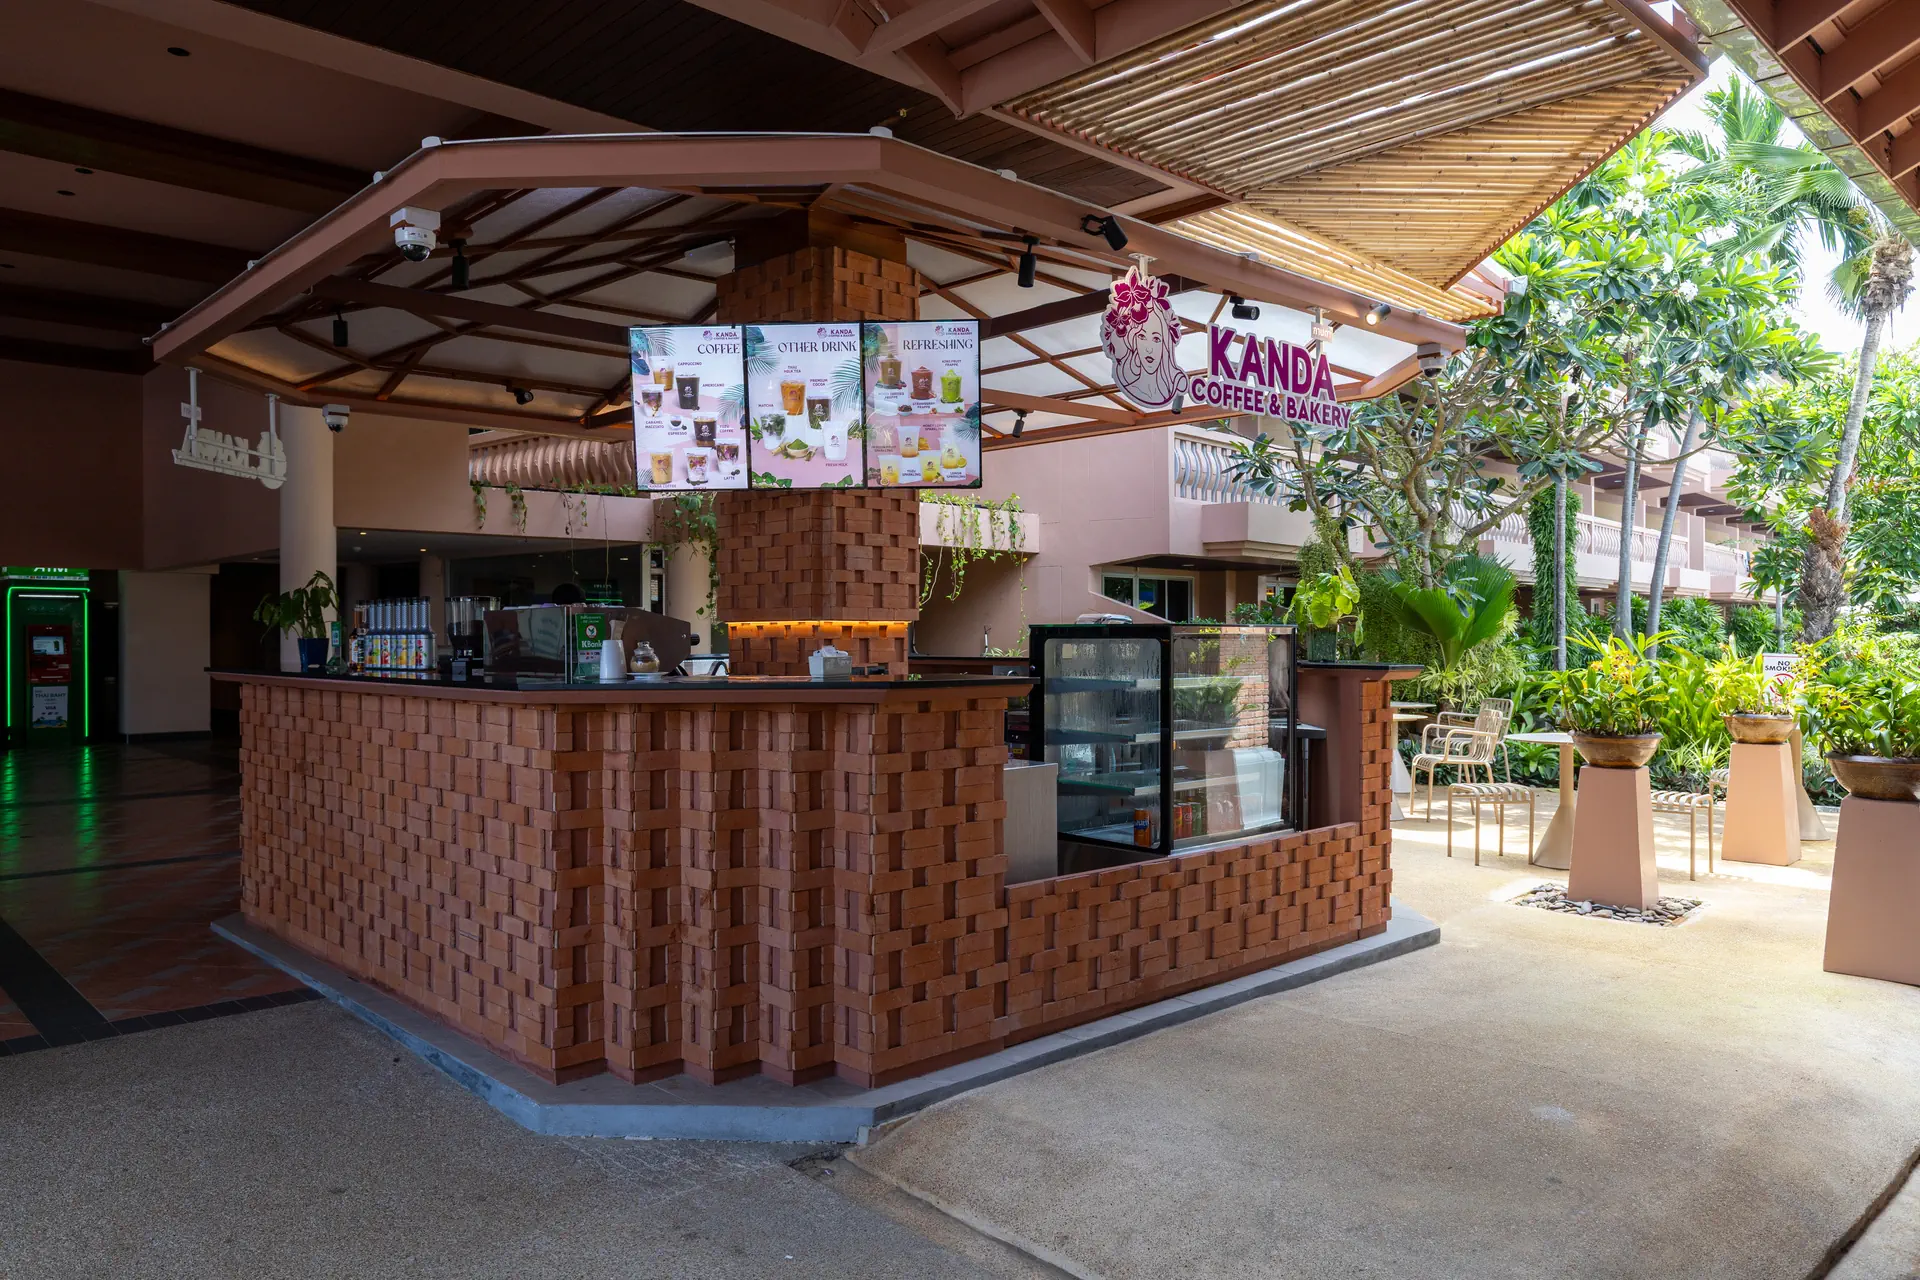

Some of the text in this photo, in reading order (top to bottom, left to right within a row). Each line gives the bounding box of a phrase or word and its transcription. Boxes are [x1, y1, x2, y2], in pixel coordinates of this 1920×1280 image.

[697, 343, 740, 355] COFFEE
[777, 340, 857, 353] OTHER DRINK
[903, 338, 973, 350] REFRESHING
[1210, 325, 1336, 403] KANDA
[1191, 378, 1352, 429] COFFEE & BAKERY
